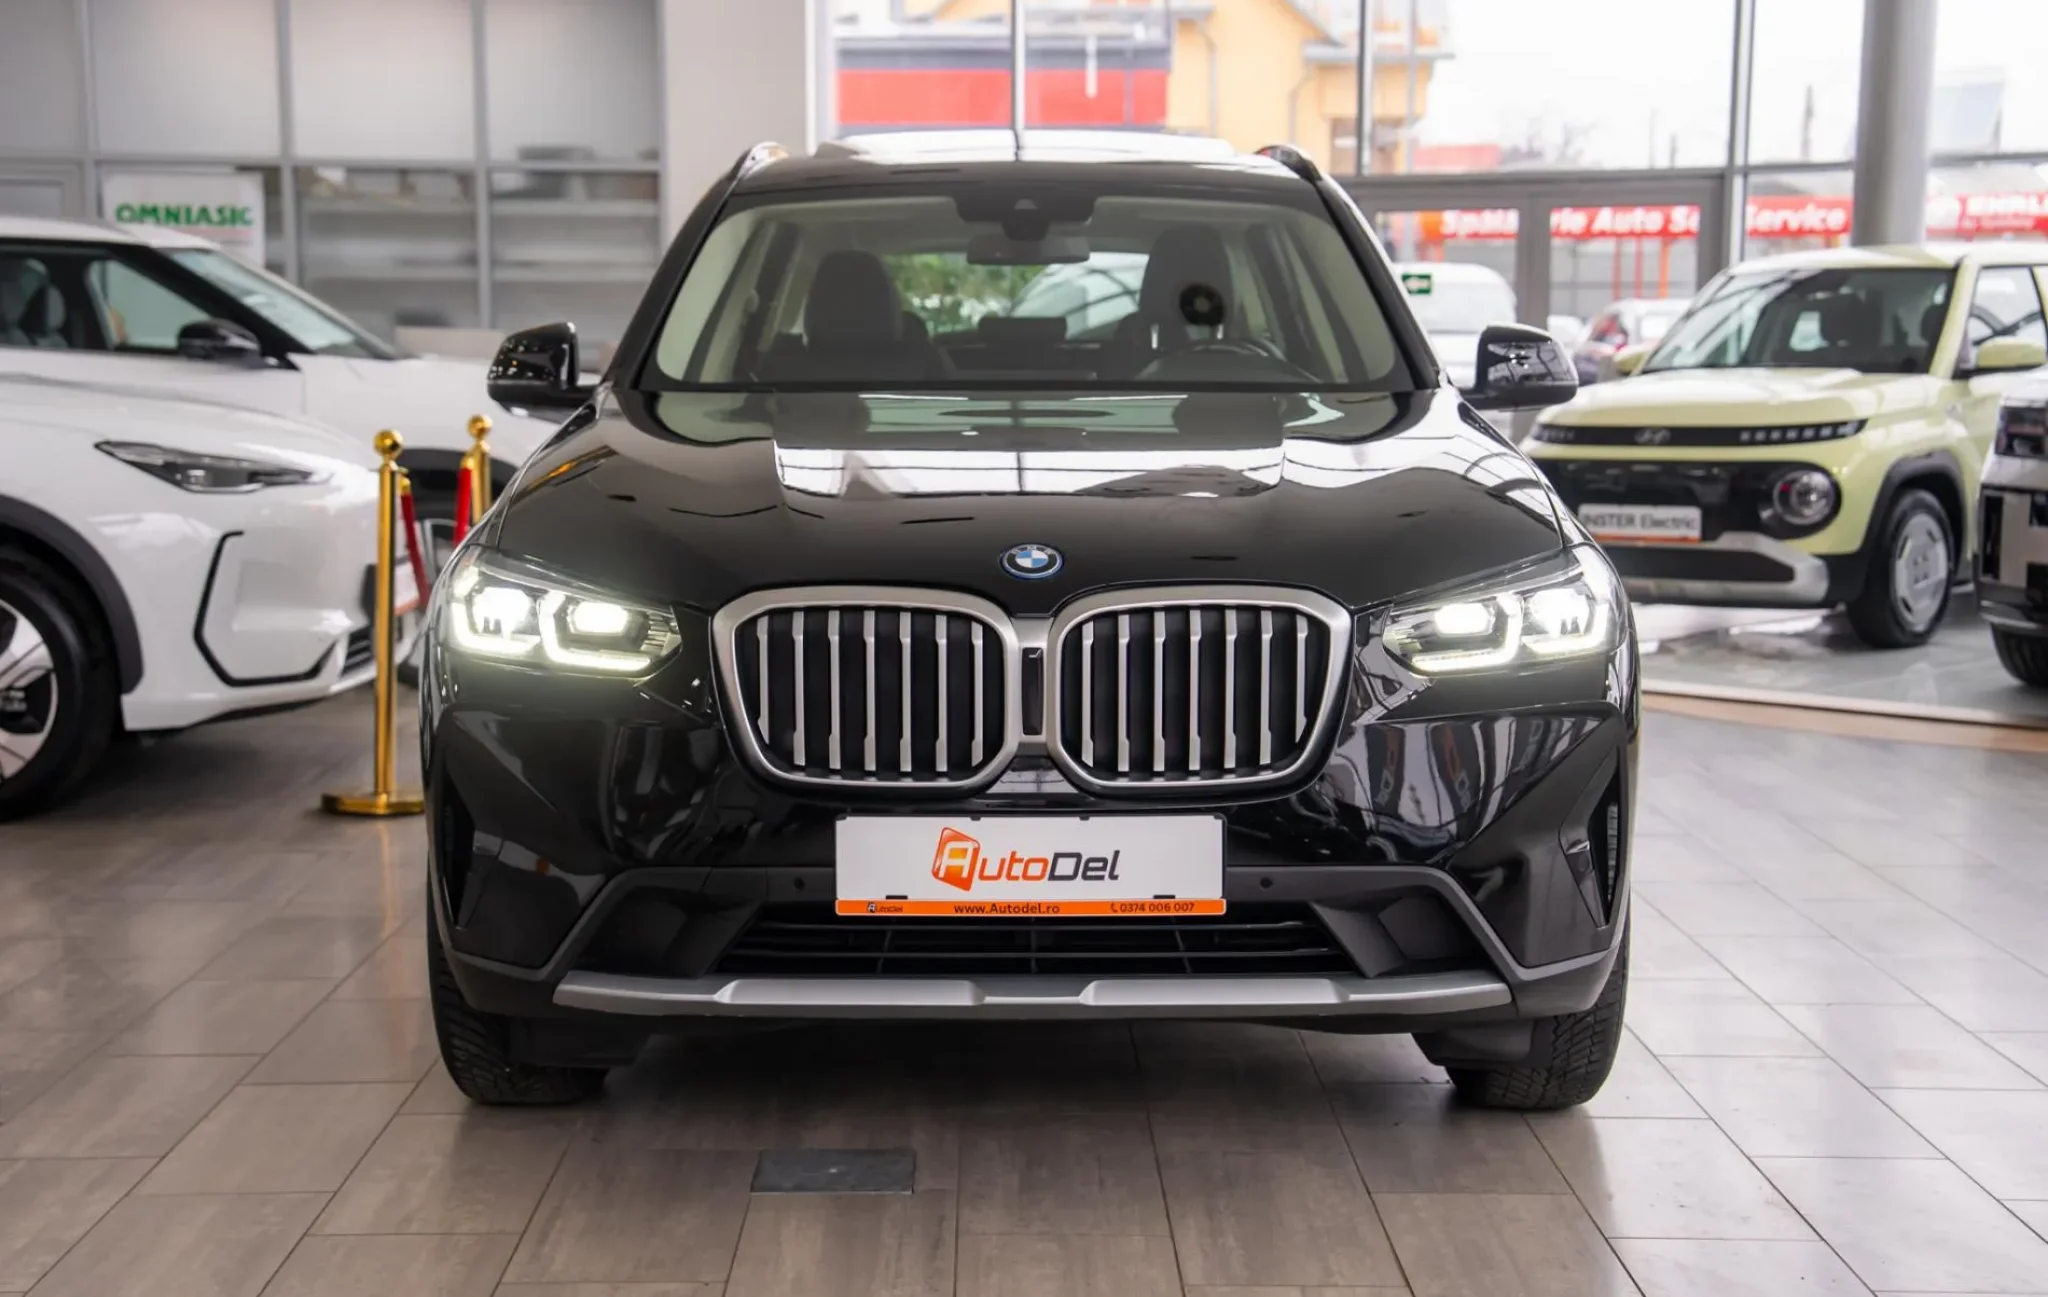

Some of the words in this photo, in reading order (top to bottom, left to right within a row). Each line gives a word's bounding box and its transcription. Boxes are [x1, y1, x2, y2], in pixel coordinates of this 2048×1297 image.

[1591, 206, 1664, 234] Auto
[1640, 513, 1697, 530] Electric
[934, 836, 1120, 884] AutoDel
[954, 902, 1060, 914] www.Autodel.ro
[1120, 902, 1145, 913] 0374
[1148, 902, 1171, 912] 006
[1173, 902, 1195, 912] 007
